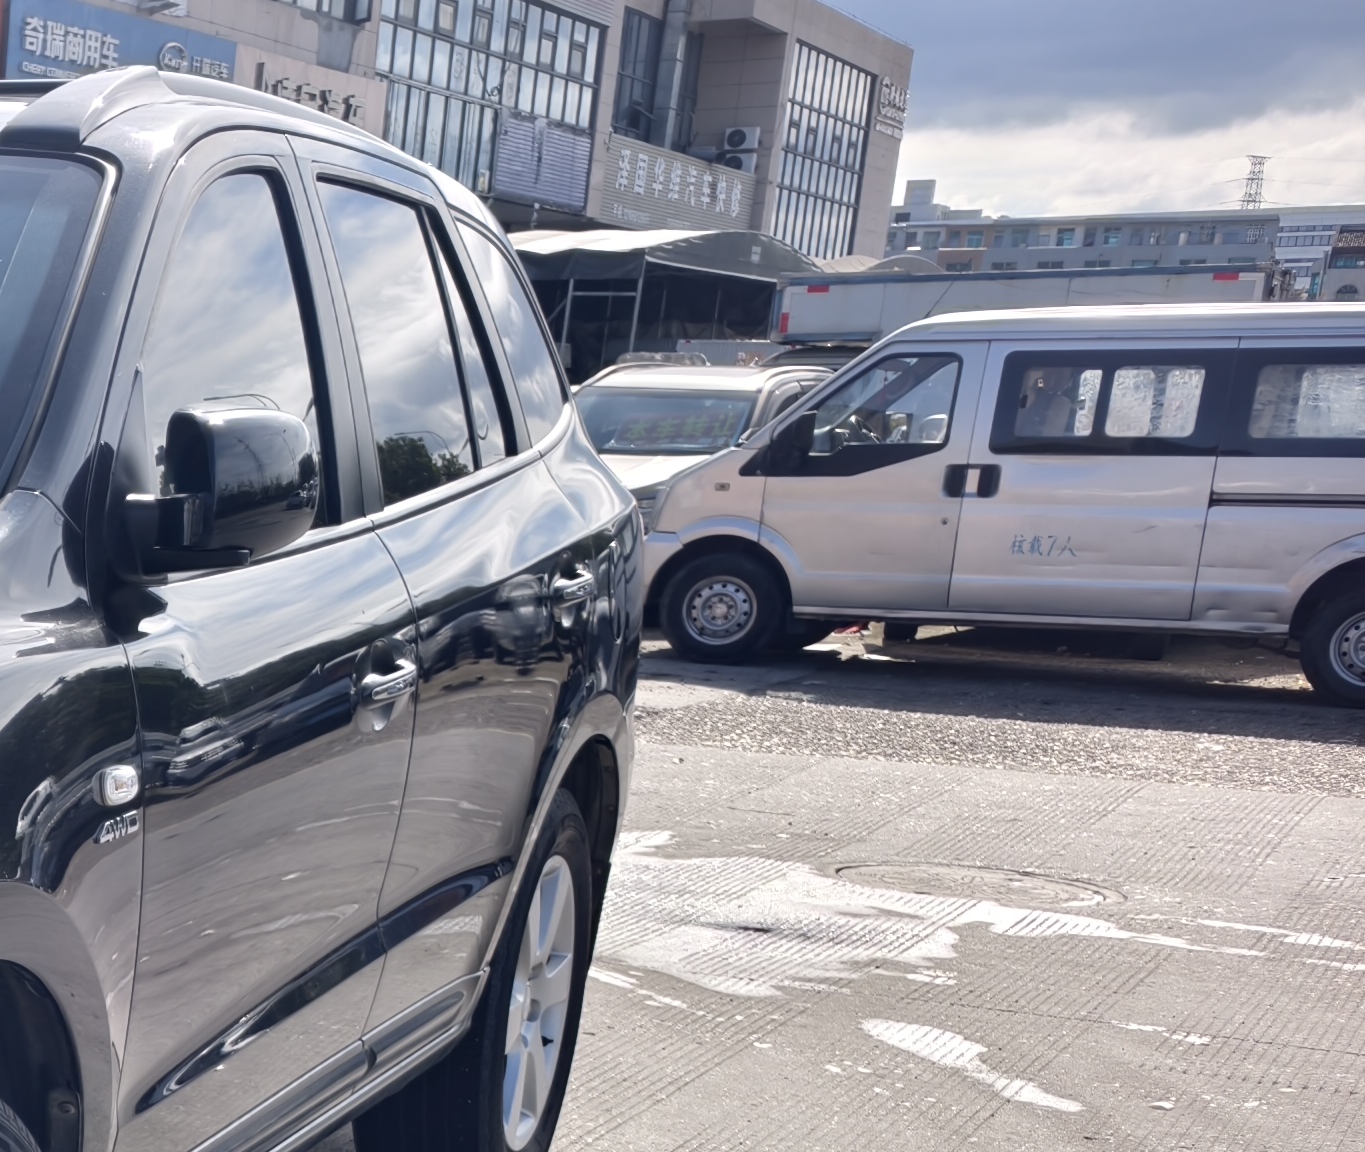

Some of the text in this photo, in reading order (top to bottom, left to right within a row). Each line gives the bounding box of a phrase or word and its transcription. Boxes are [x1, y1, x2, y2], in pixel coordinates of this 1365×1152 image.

[24, 16, 120, 69] 奇瑞商用车
